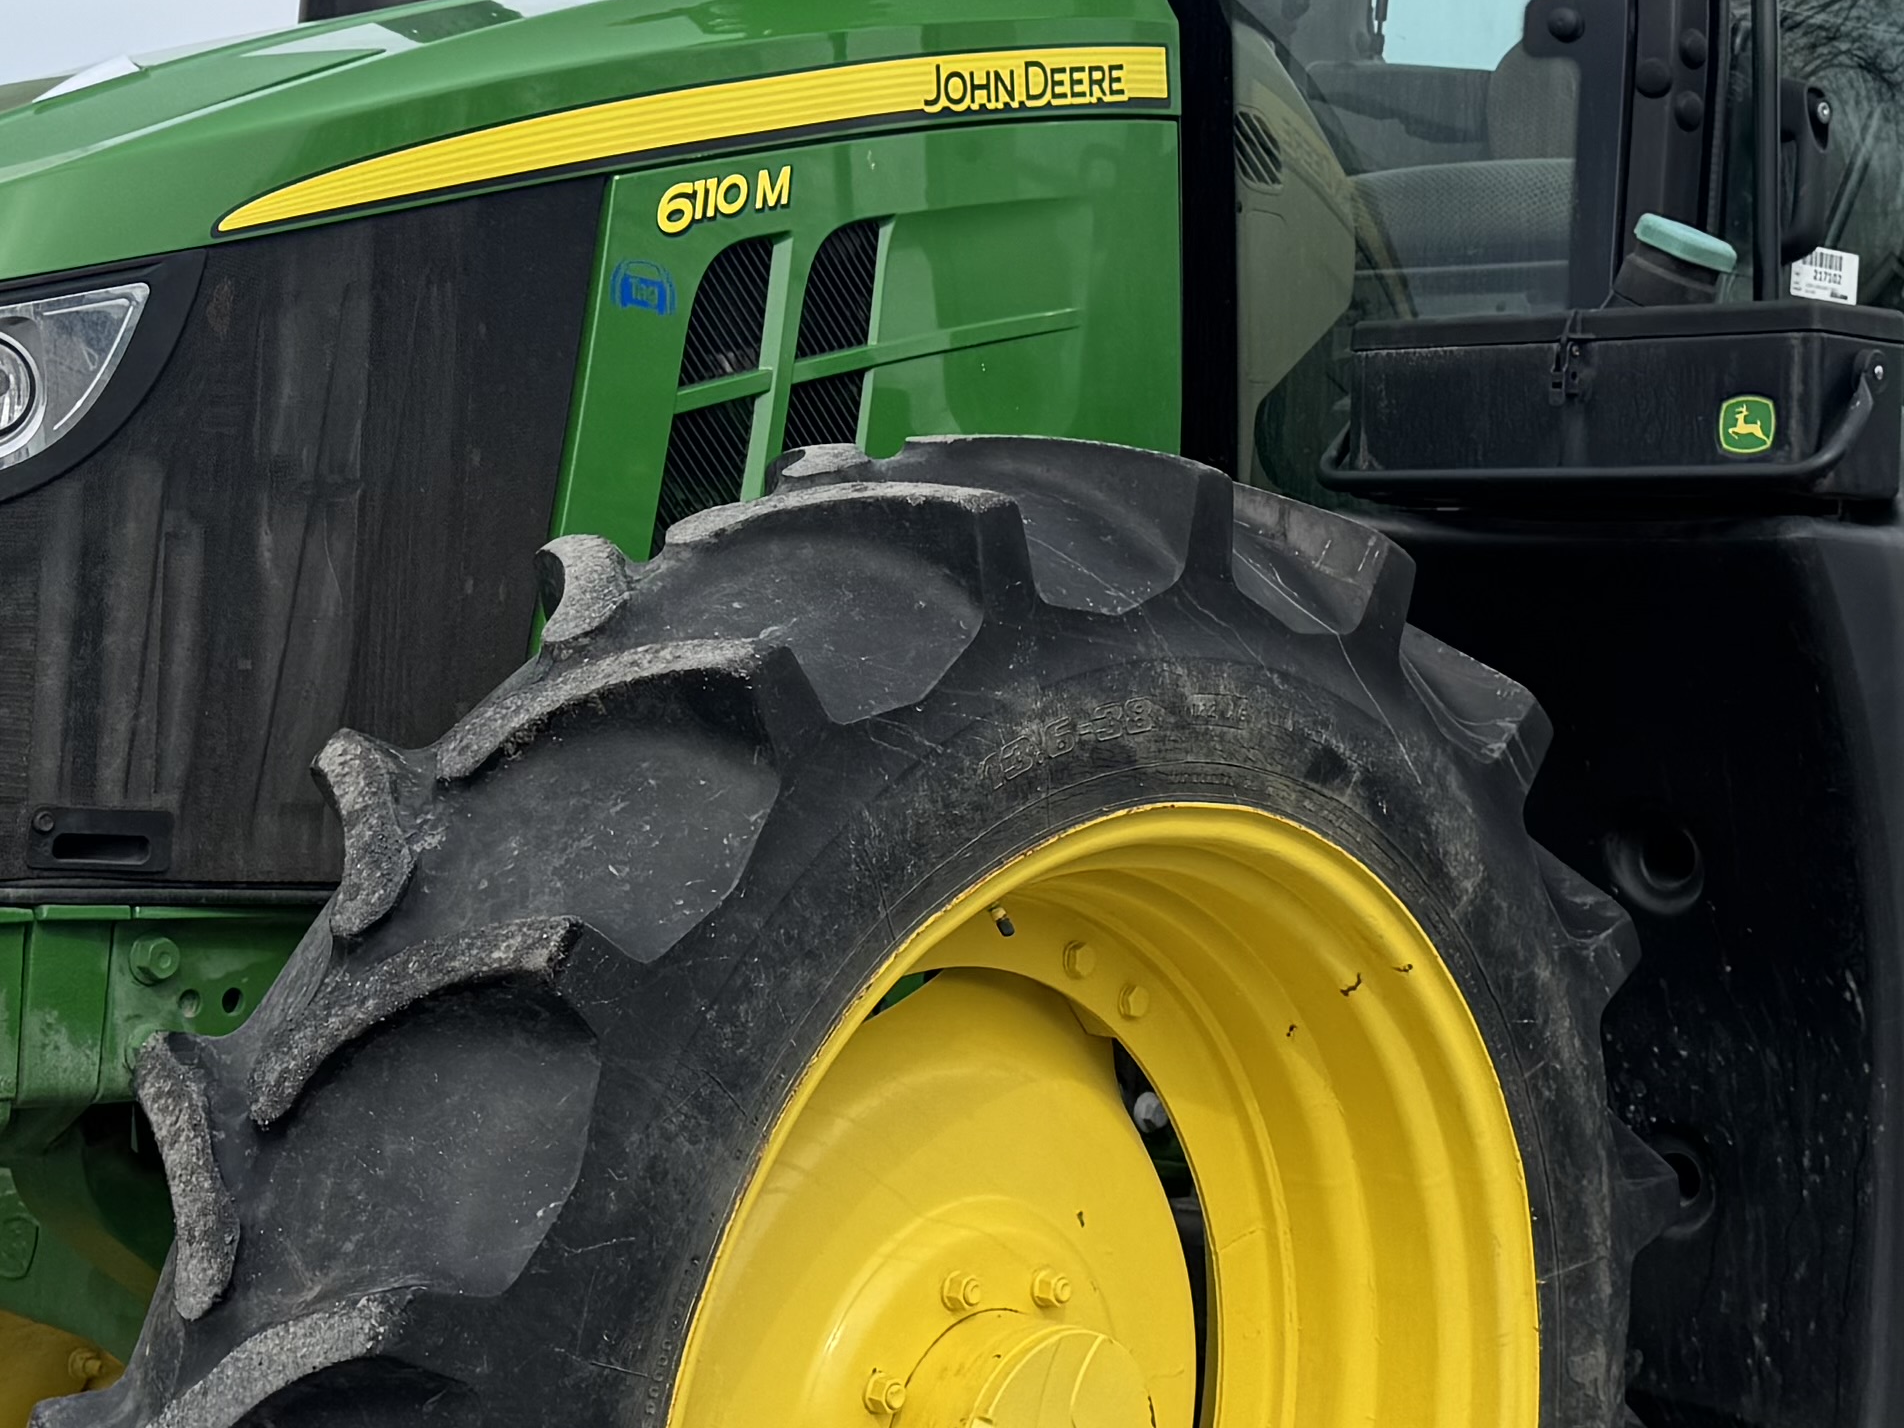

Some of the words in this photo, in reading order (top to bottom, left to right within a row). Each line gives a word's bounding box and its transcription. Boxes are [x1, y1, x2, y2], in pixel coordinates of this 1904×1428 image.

[924, 63, 1016, 107] JOHN
[1024, 60, 1125, 101] DEERE
[657, 173, 749, 234] 6110
[755, 165, 792, 210] M
